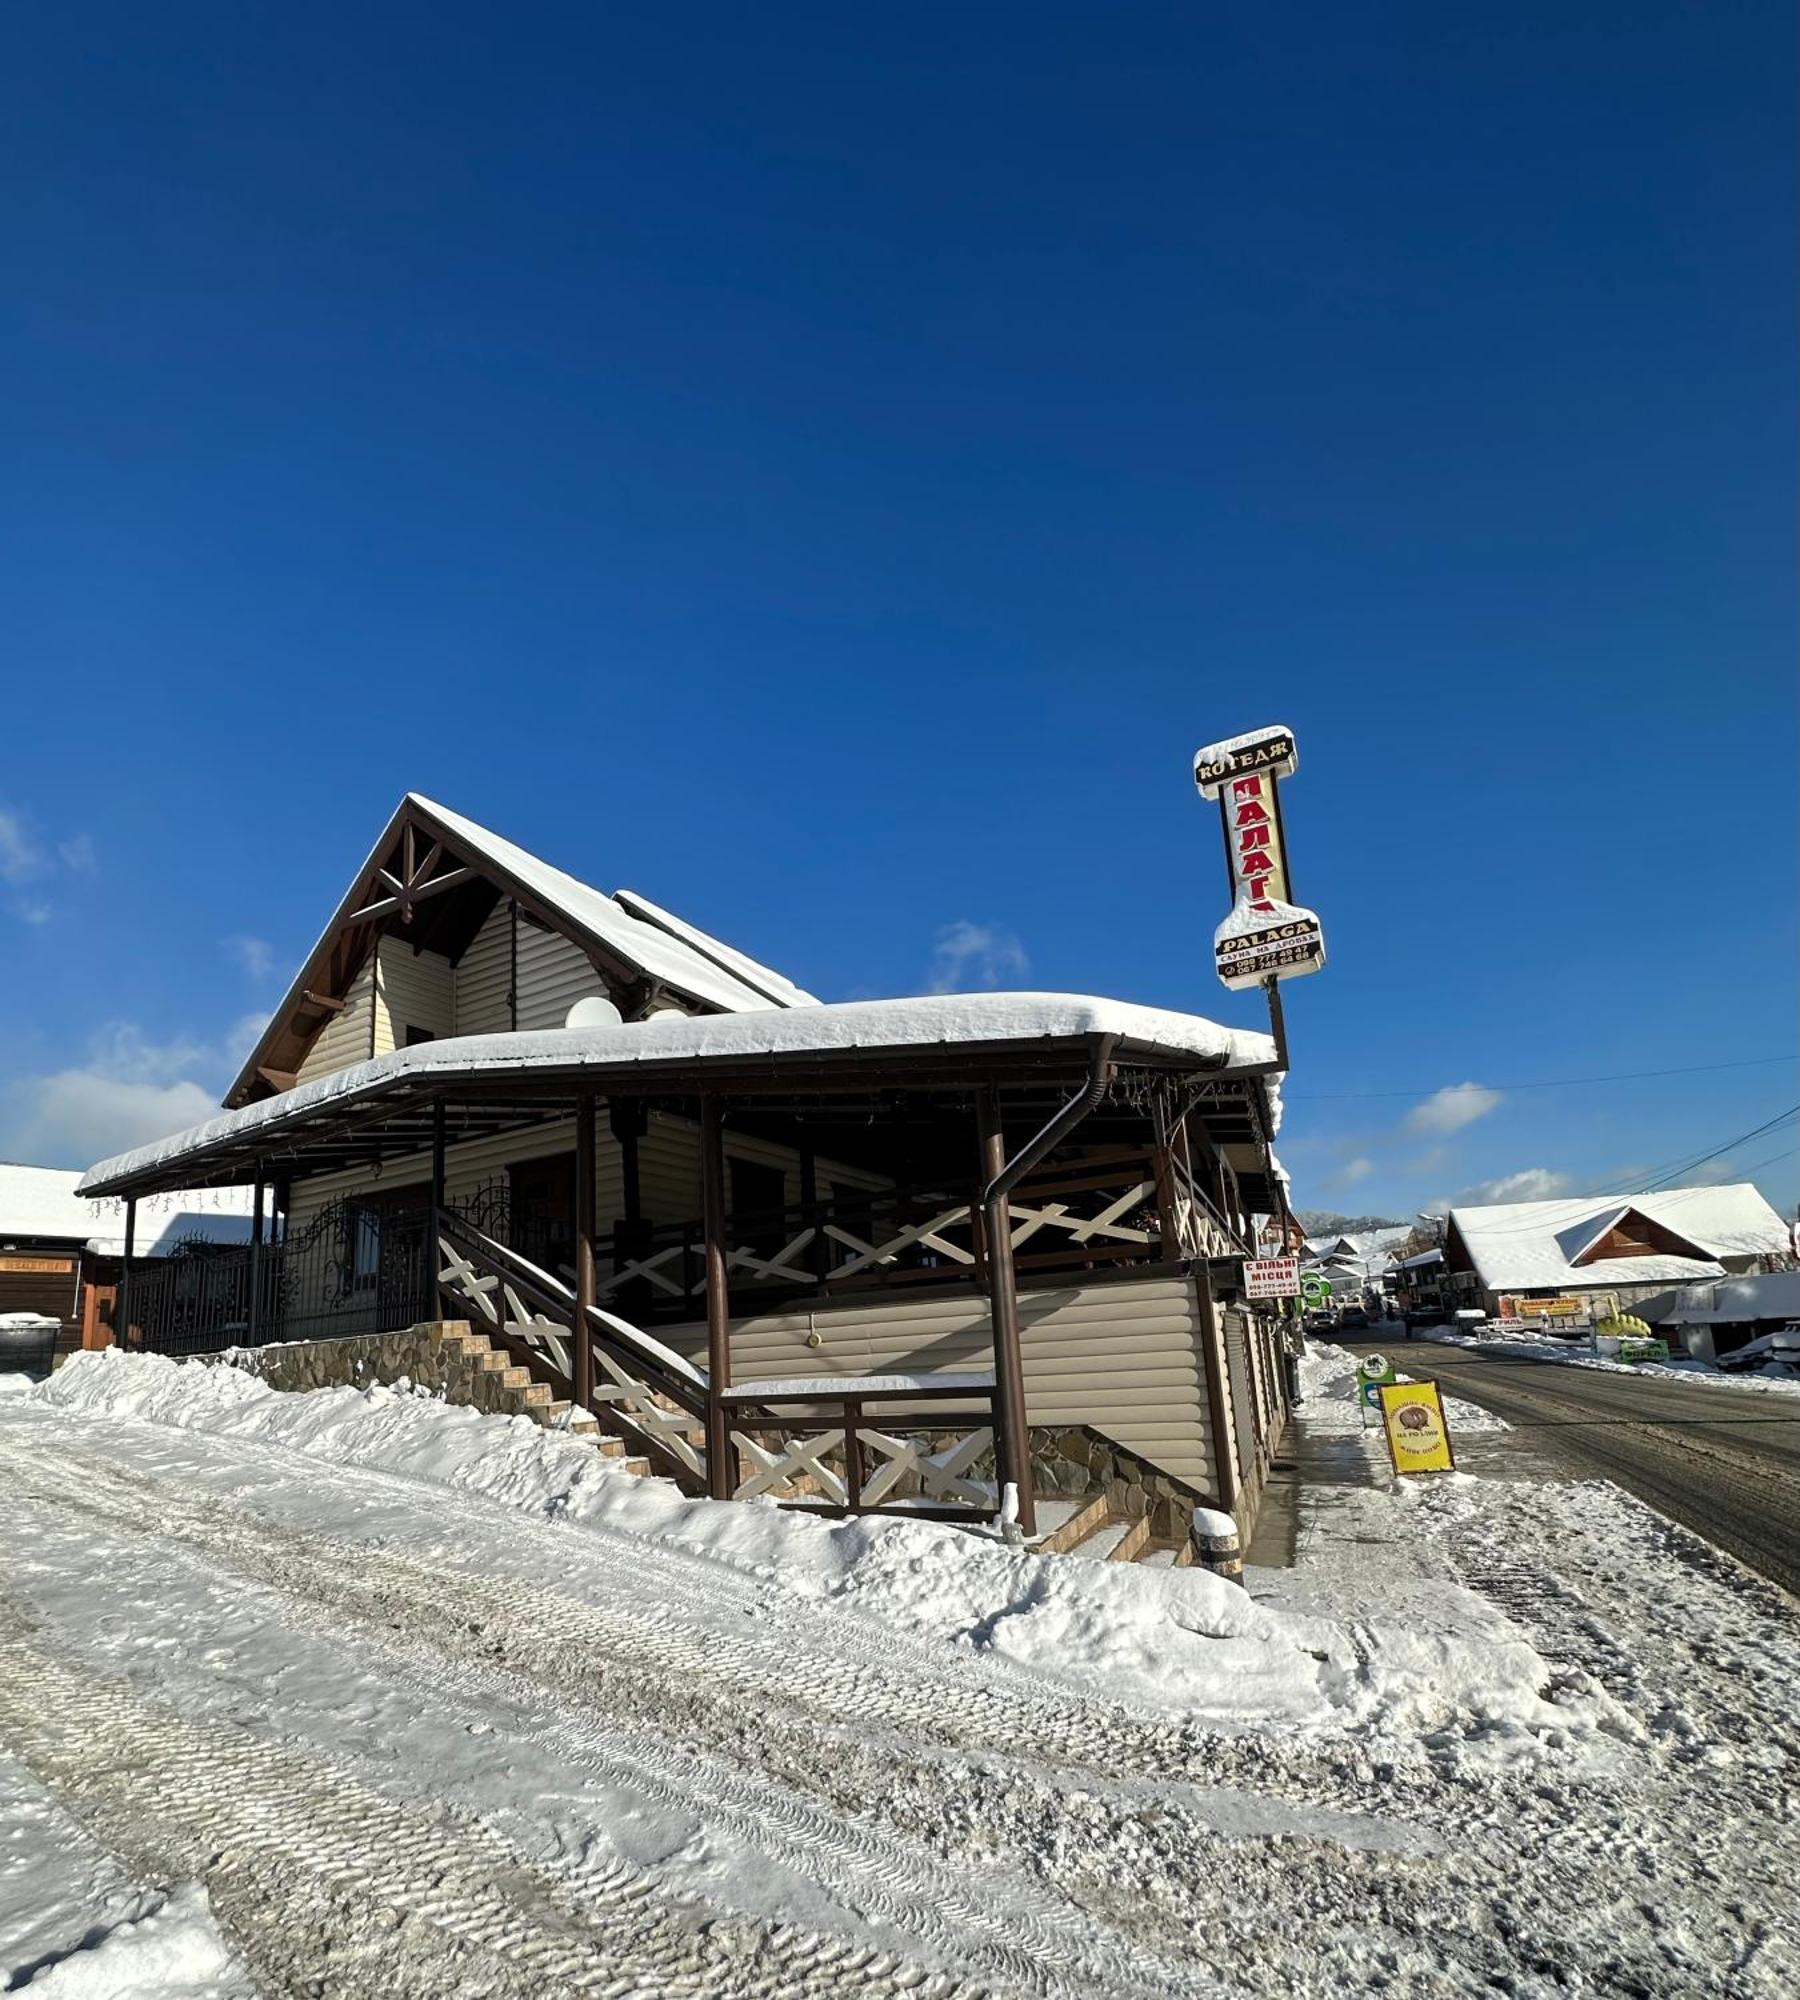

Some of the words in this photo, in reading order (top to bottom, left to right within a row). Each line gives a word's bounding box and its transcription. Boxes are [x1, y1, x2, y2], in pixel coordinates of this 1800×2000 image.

[1223, 922, 1310, 952] PALAGA
[1221, 950, 1250, 962] САУНА
[1257, 945, 1270, 953] НА
[1275, 934, 1315, 950] ДРОВАХ
[1258, 952, 1276, 962] 777
[1295, 944, 1308, 953] 47
[1256, 1259, 1296, 1270] ВІЛЬНІ
[1251, 1270, 1292, 1281] МІСЦЯ
